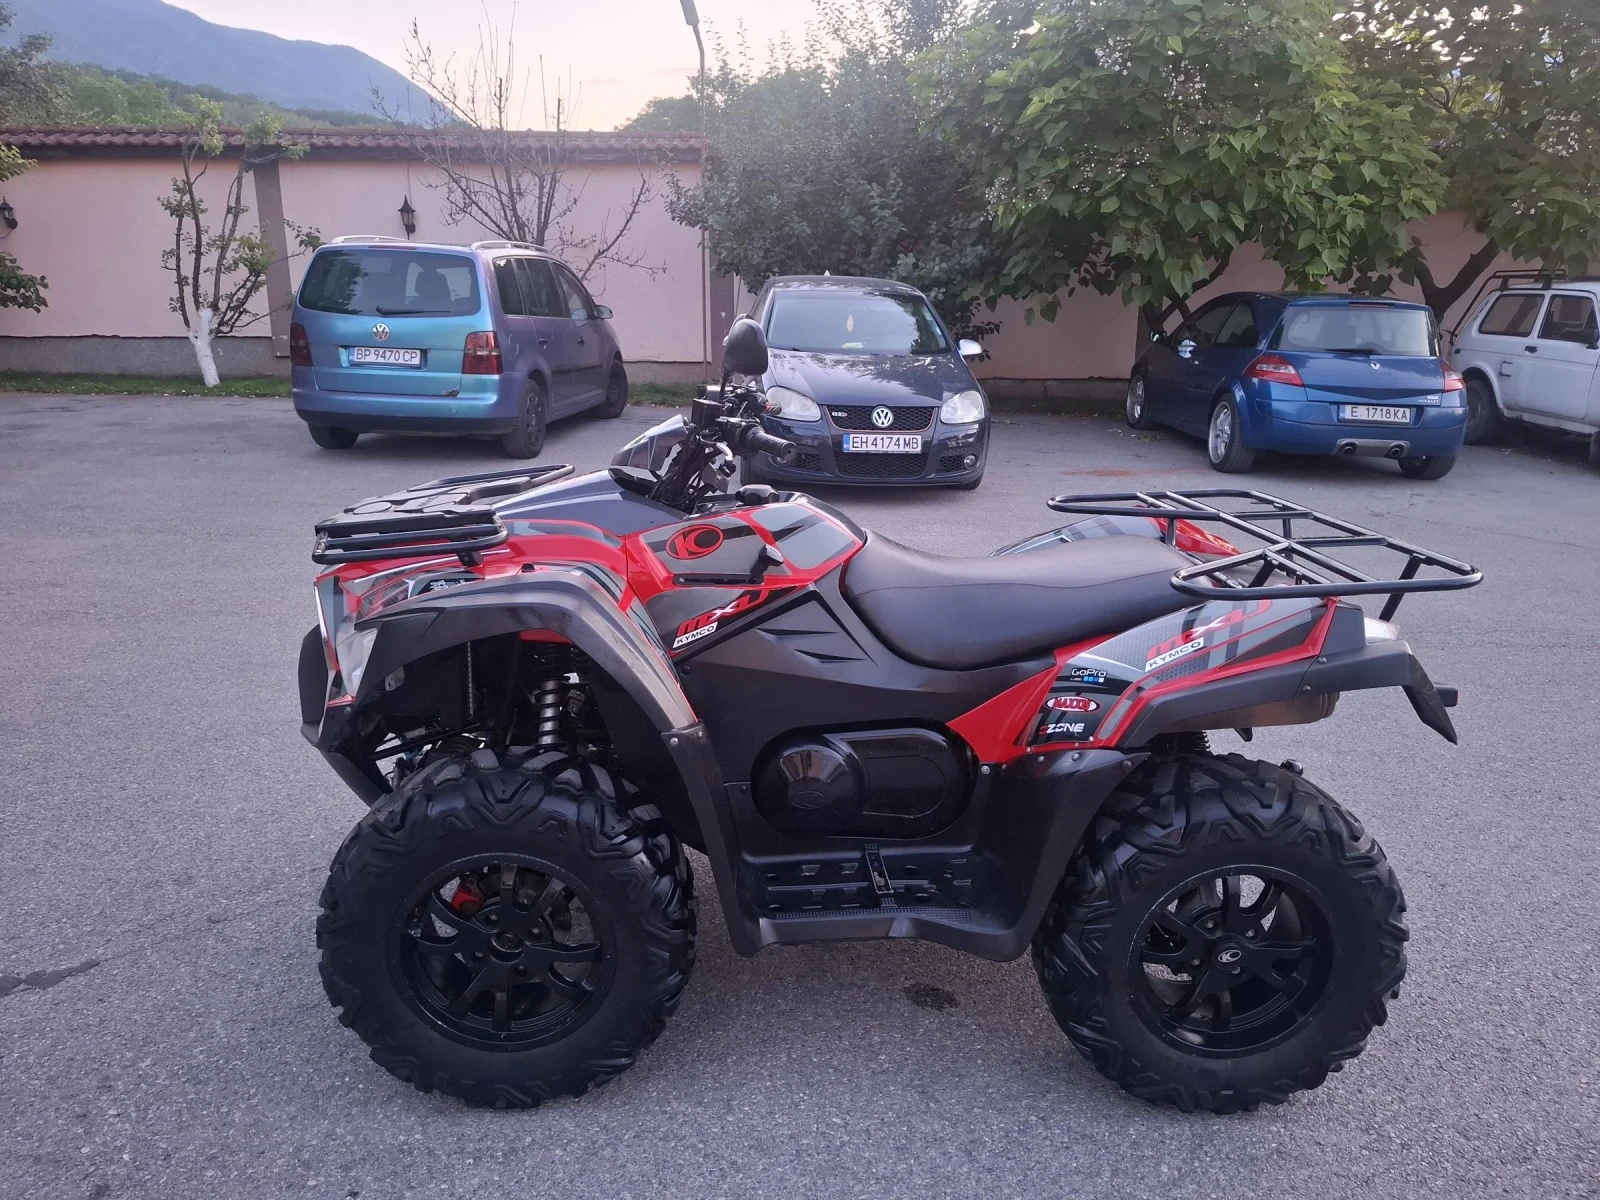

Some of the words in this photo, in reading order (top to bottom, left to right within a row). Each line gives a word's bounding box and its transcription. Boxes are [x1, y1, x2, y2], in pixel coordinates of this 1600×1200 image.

[356, 348, 371, 360] BP
[373, 349, 401, 362] 9470
[402, 350, 418, 363] CP
[1365, 407, 1392, 420] 1718
[1393, 408, 1408, 421] KA
[851, 436, 869, 449] EH
[871, 436, 901, 449] 4174
[903, 437, 919, 450] MB
[676, 625, 715, 645] KYMCO
[1148, 640, 1201, 668] KYMCO
[1071, 668, 1107, 677] GoPro
[1053, 697, 1092, 711] MAXXIS
